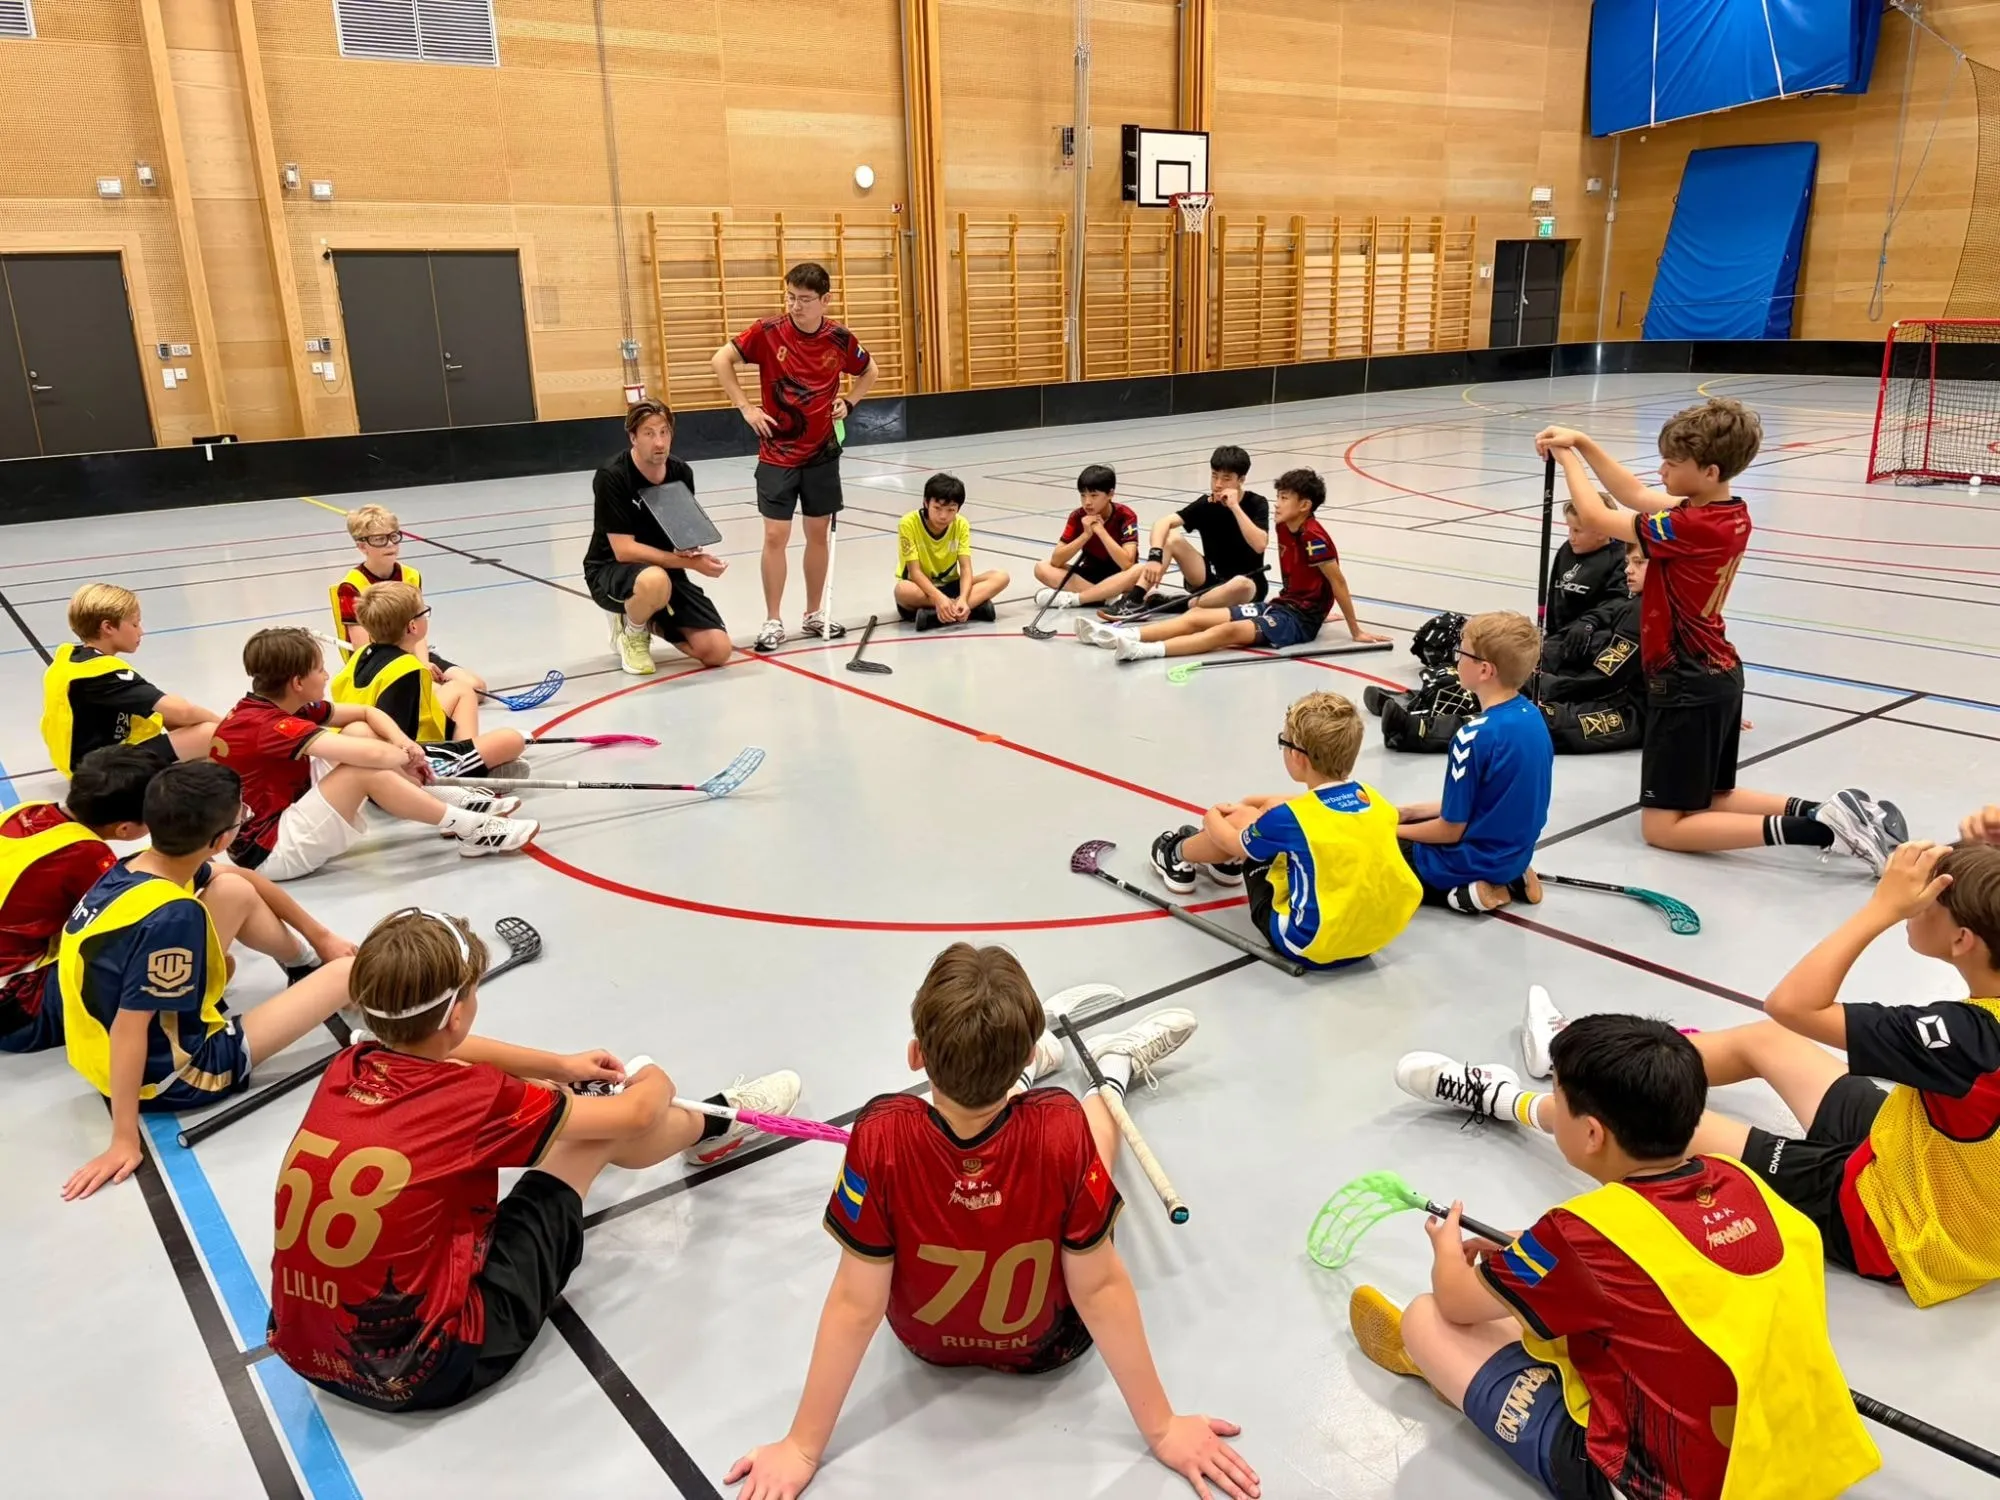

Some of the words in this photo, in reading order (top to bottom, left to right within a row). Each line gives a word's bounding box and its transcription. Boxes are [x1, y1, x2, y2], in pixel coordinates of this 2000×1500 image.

[275, 1128, 412, 1268] 58
[283, 1267, 338, 1309] LILLO
[911, 1238, 1054, 1334] 70
[941, 1334, 1028, 1350] RUBEN
